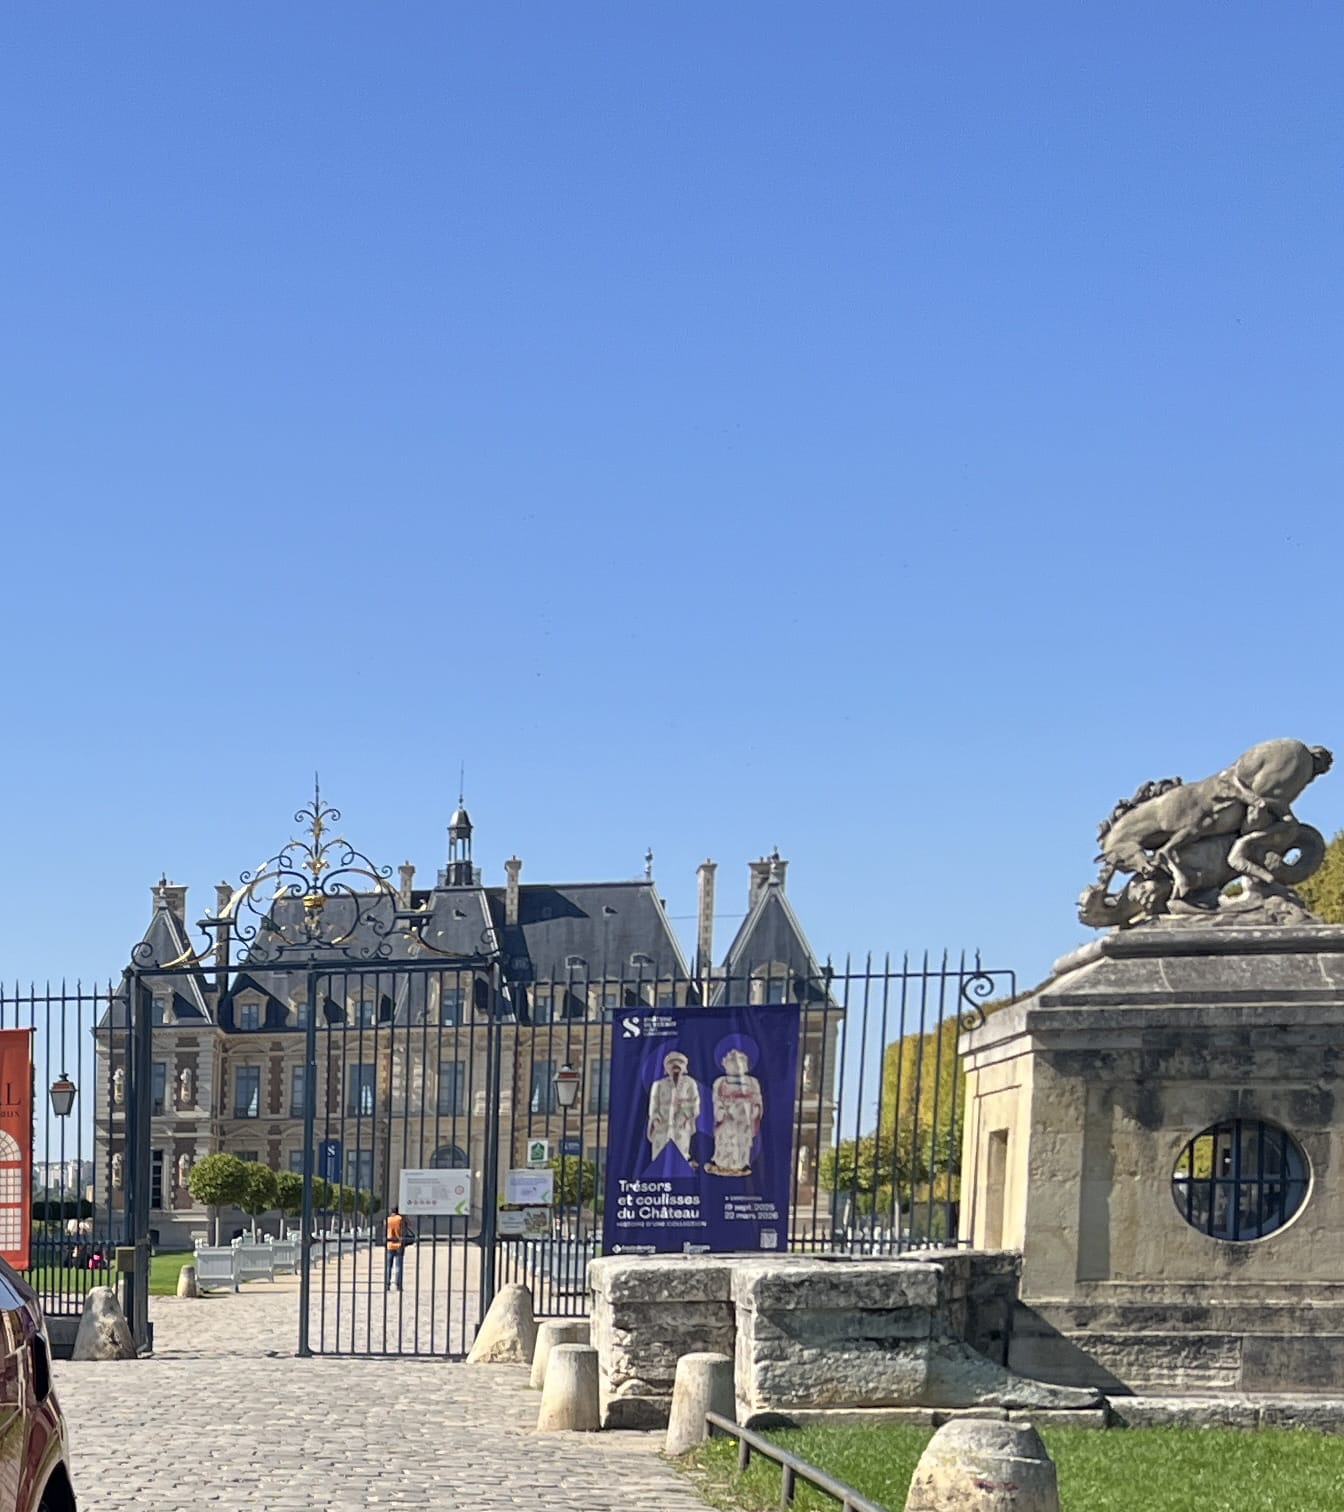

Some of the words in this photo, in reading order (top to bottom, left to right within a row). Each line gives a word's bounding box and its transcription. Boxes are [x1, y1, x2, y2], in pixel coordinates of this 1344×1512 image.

[618, 1179, 672, 1193] Trésors
[617, 1194, 633, 1206] et
[635, 1193, 701, 1206] coulisses
[617, 1207, 635, 1220] du
[638, 1206, 700, 1220] Château
[724, 1211, 735, 1220] 22
[736, 1212, 756, 1220] mars
[757, 1211, 779, 1220] 2026
